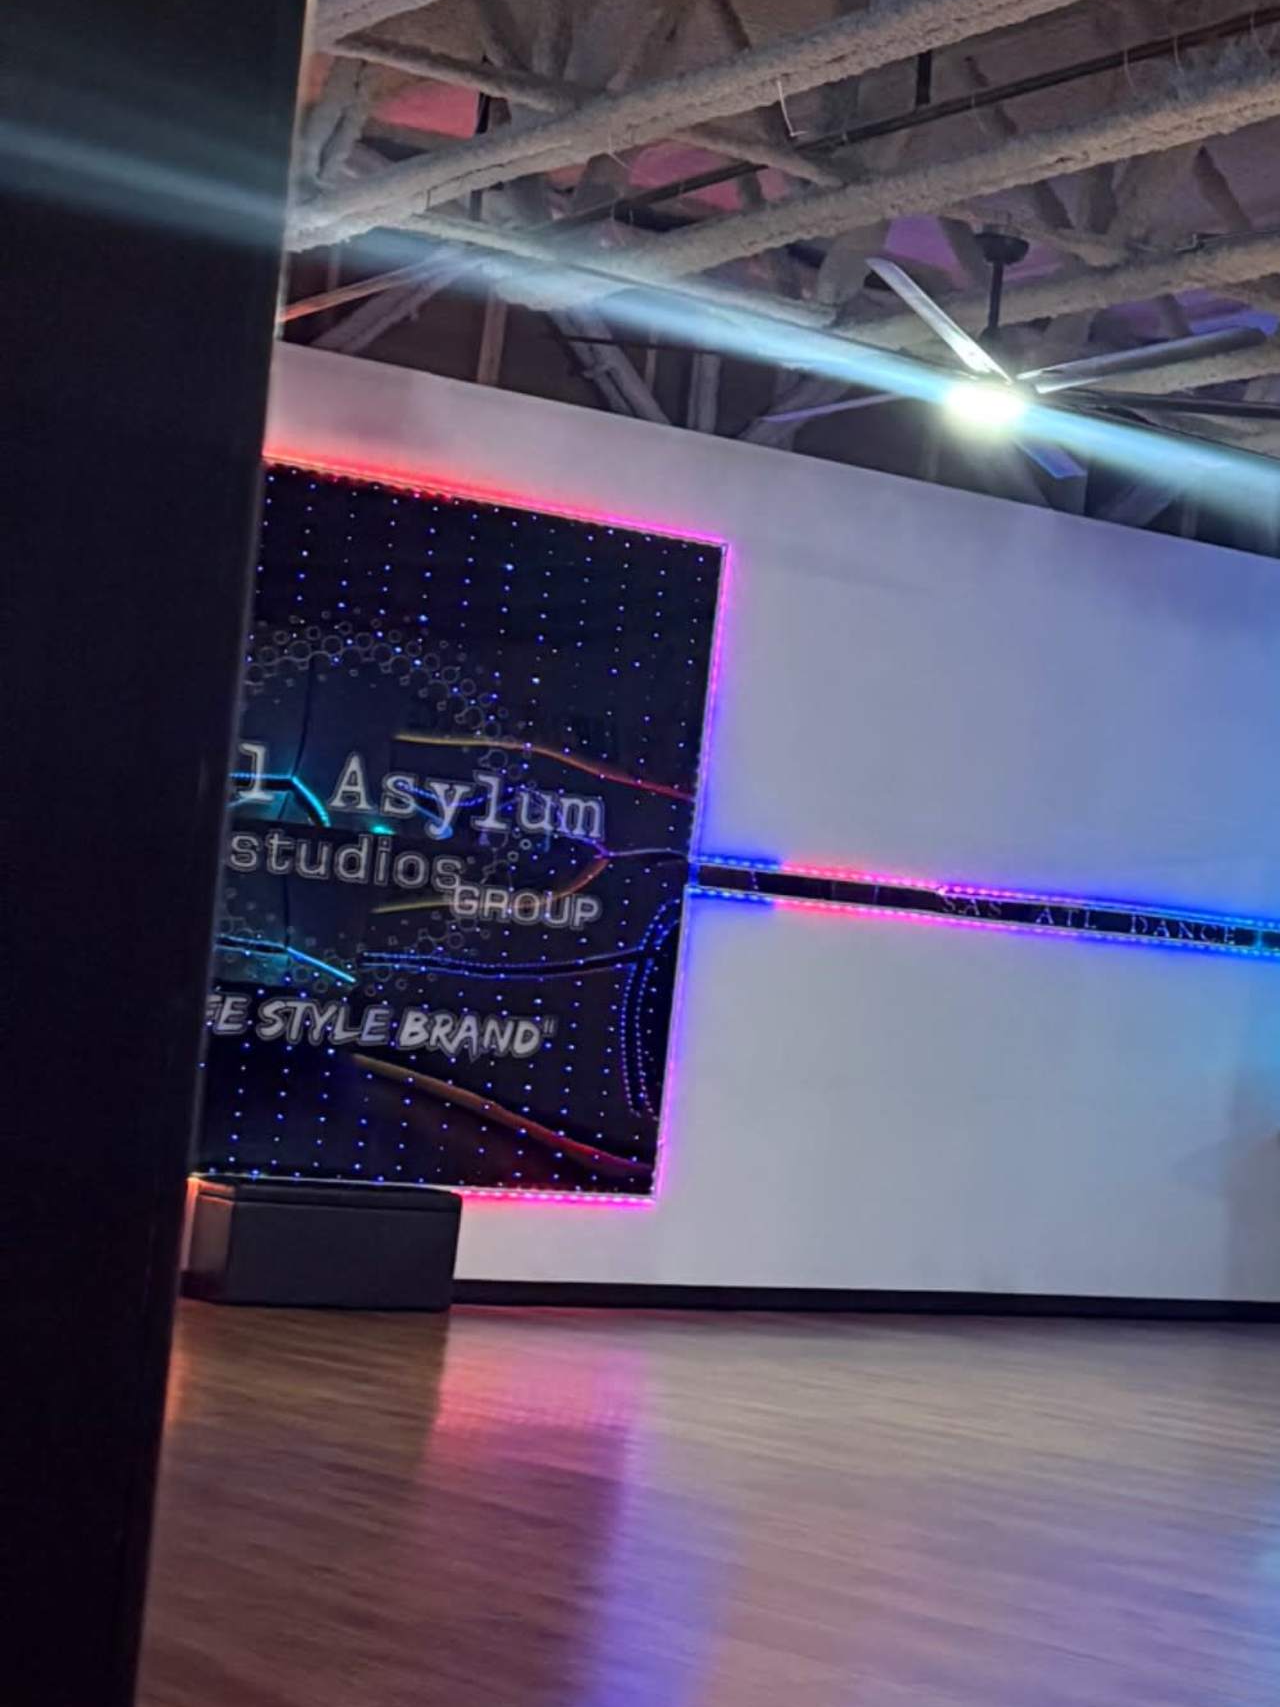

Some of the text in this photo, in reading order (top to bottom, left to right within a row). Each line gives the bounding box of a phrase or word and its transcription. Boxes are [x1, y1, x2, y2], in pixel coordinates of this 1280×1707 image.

[328, 751, 606, 840] Asylum
[227, 831, 466, 889] studios
[450, 882, 601, 929] GROUP
[942, 894, 1236, 945] SAS ATL DANCE
[255, 998, 397, 1047] STYLE
